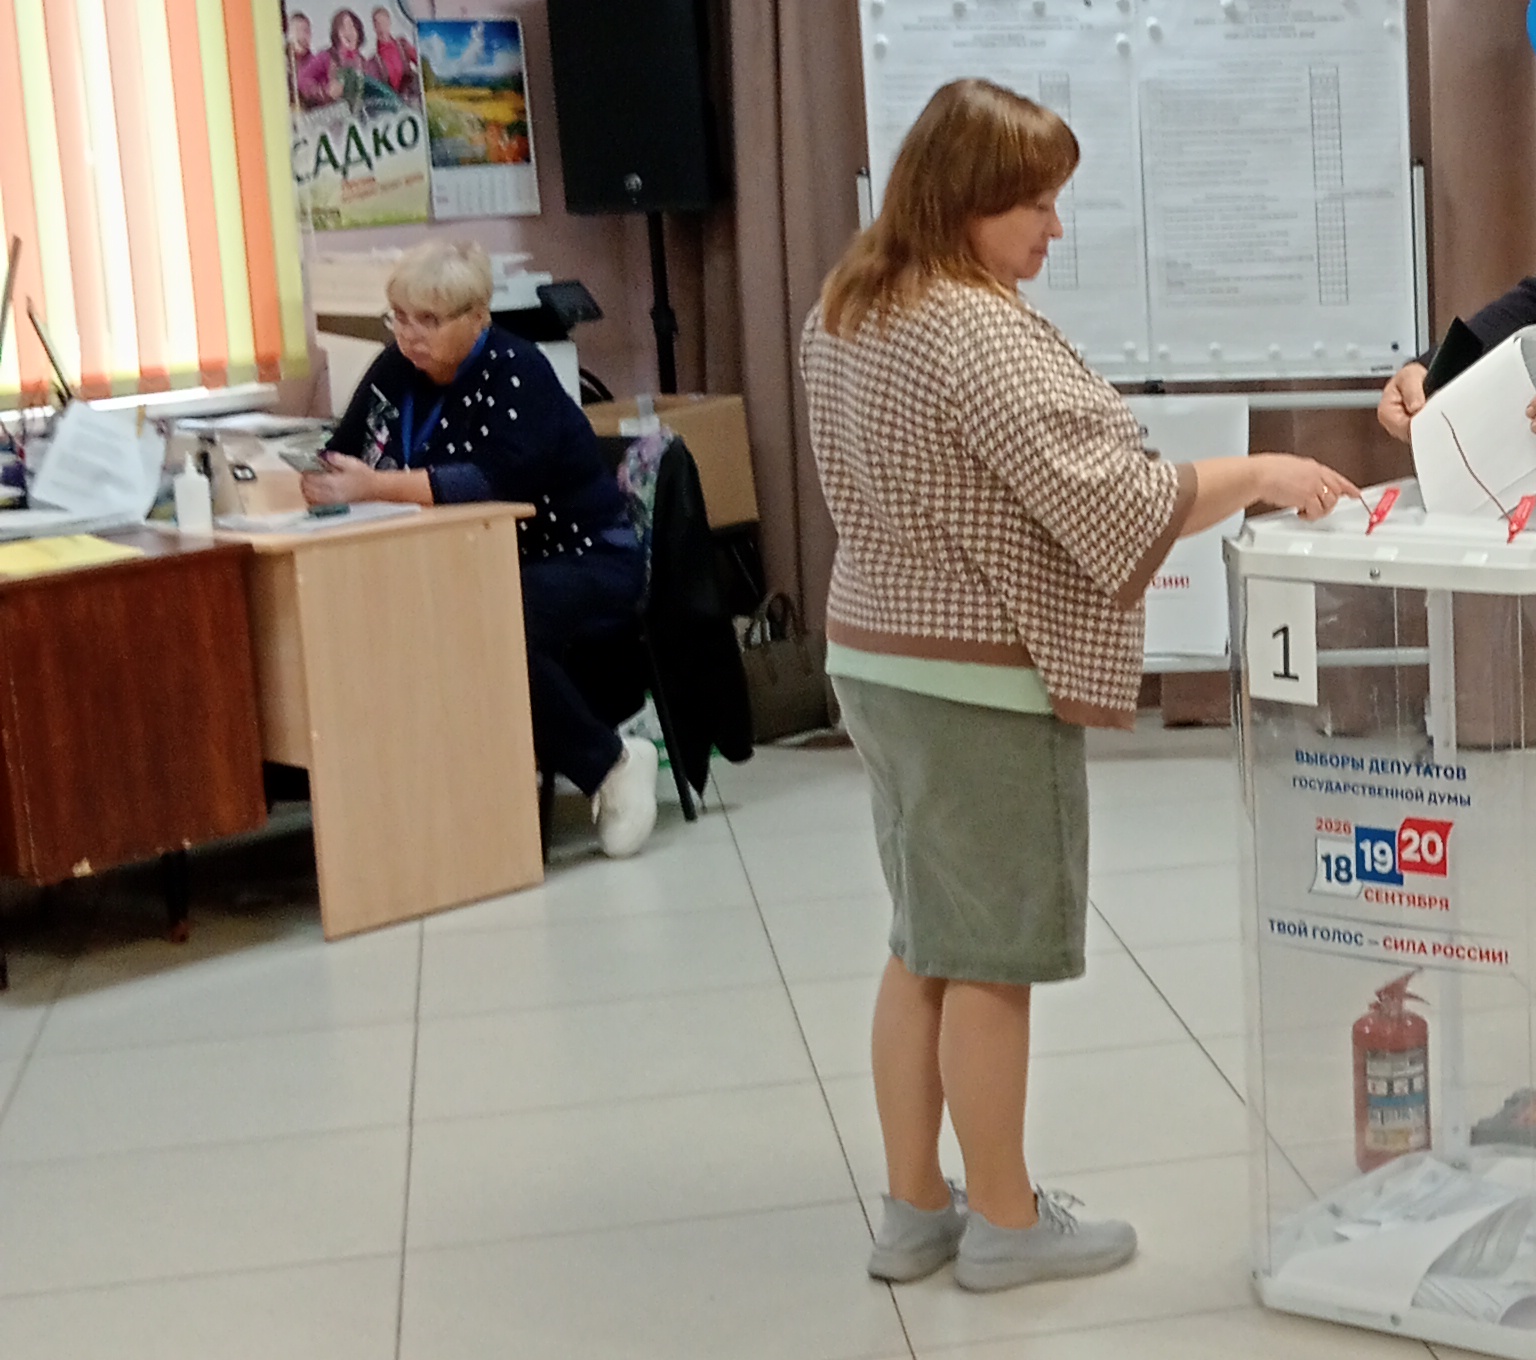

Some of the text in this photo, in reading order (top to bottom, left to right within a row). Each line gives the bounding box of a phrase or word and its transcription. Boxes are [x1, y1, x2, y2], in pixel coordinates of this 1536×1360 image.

[1272, 625, 1299, 681] 1
[1295, 749, 1467, 781] ВЫБОРЫ ДЕПУТАТОВ
[1292, 776, 1471, 807] ГОСУДАРСТВЕННОЙ ДУМЫ
[1321, 828, 1443, 883] 18 19 20
[1364, 889, 1450, 911] СЕНТЯБРЯ
[1269, 918, 1308, 938] ТВОЙ
[1312, 927, 1364, 946] ГОЛОС
[1383, 936, 1427, 956] СИЛА
[1432, 941, 1509, 964] РОССИИ!
